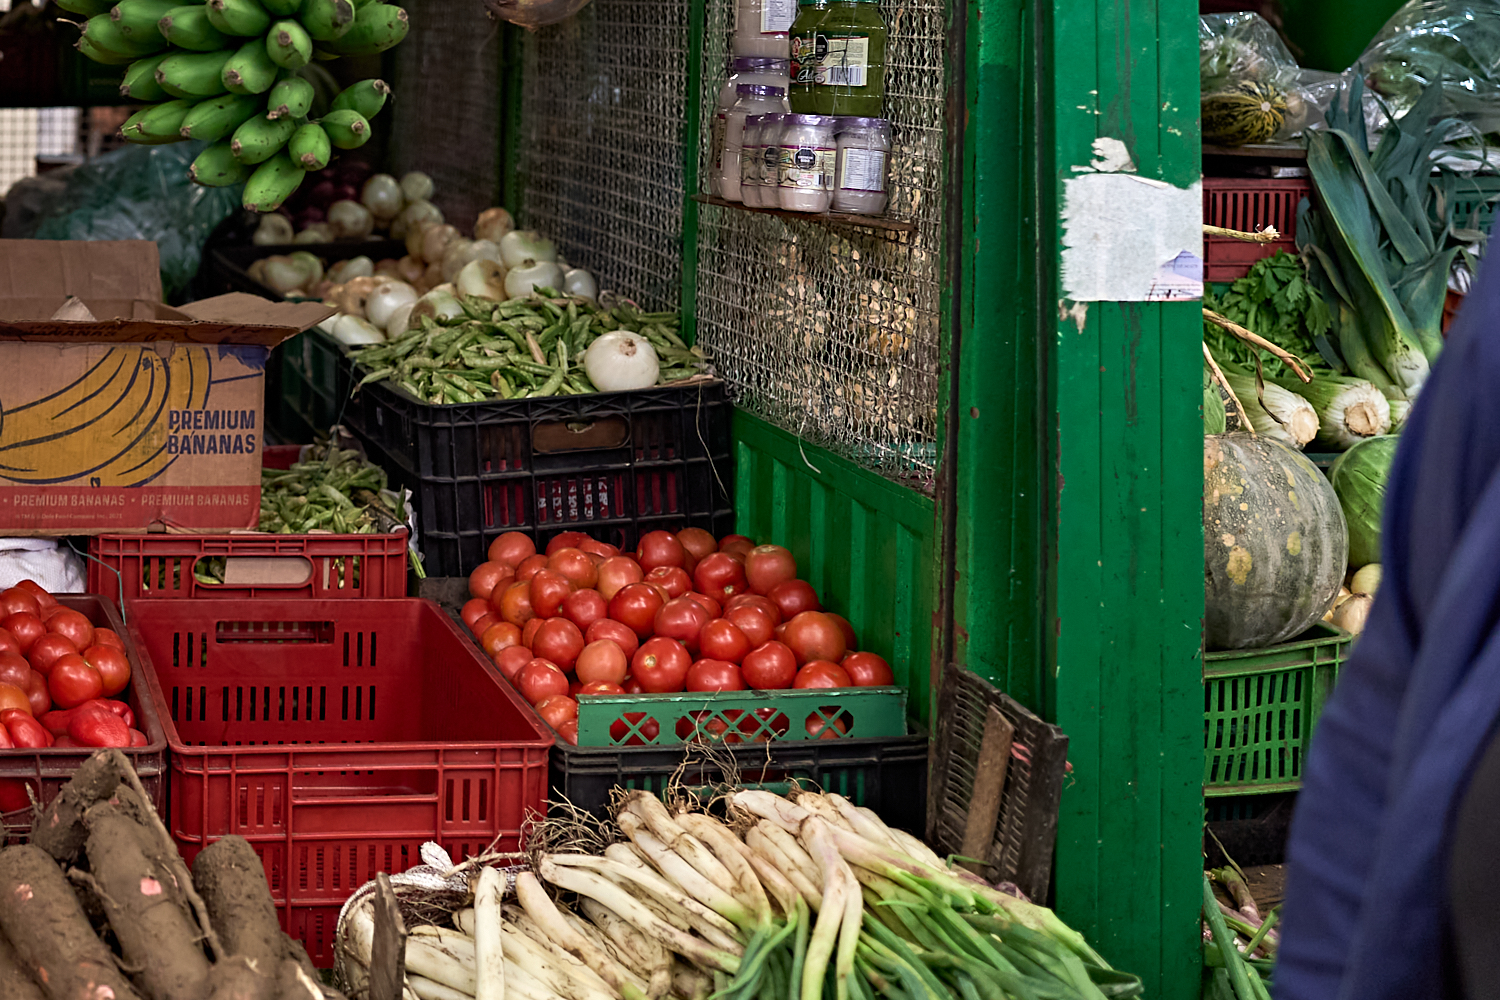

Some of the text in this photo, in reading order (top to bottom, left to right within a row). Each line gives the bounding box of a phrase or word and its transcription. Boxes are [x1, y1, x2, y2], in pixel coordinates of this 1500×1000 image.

[169, 410, 256, 430] PREMIUM
[167, 434, 256, 455] BANANAS
[14, 494, 68, 507] PREMIUM
[71, 494, 126, 506] BANANAS
[141, 494, 195, 506] PREMIUM
[197, 494, 250, 506] BANANAS
